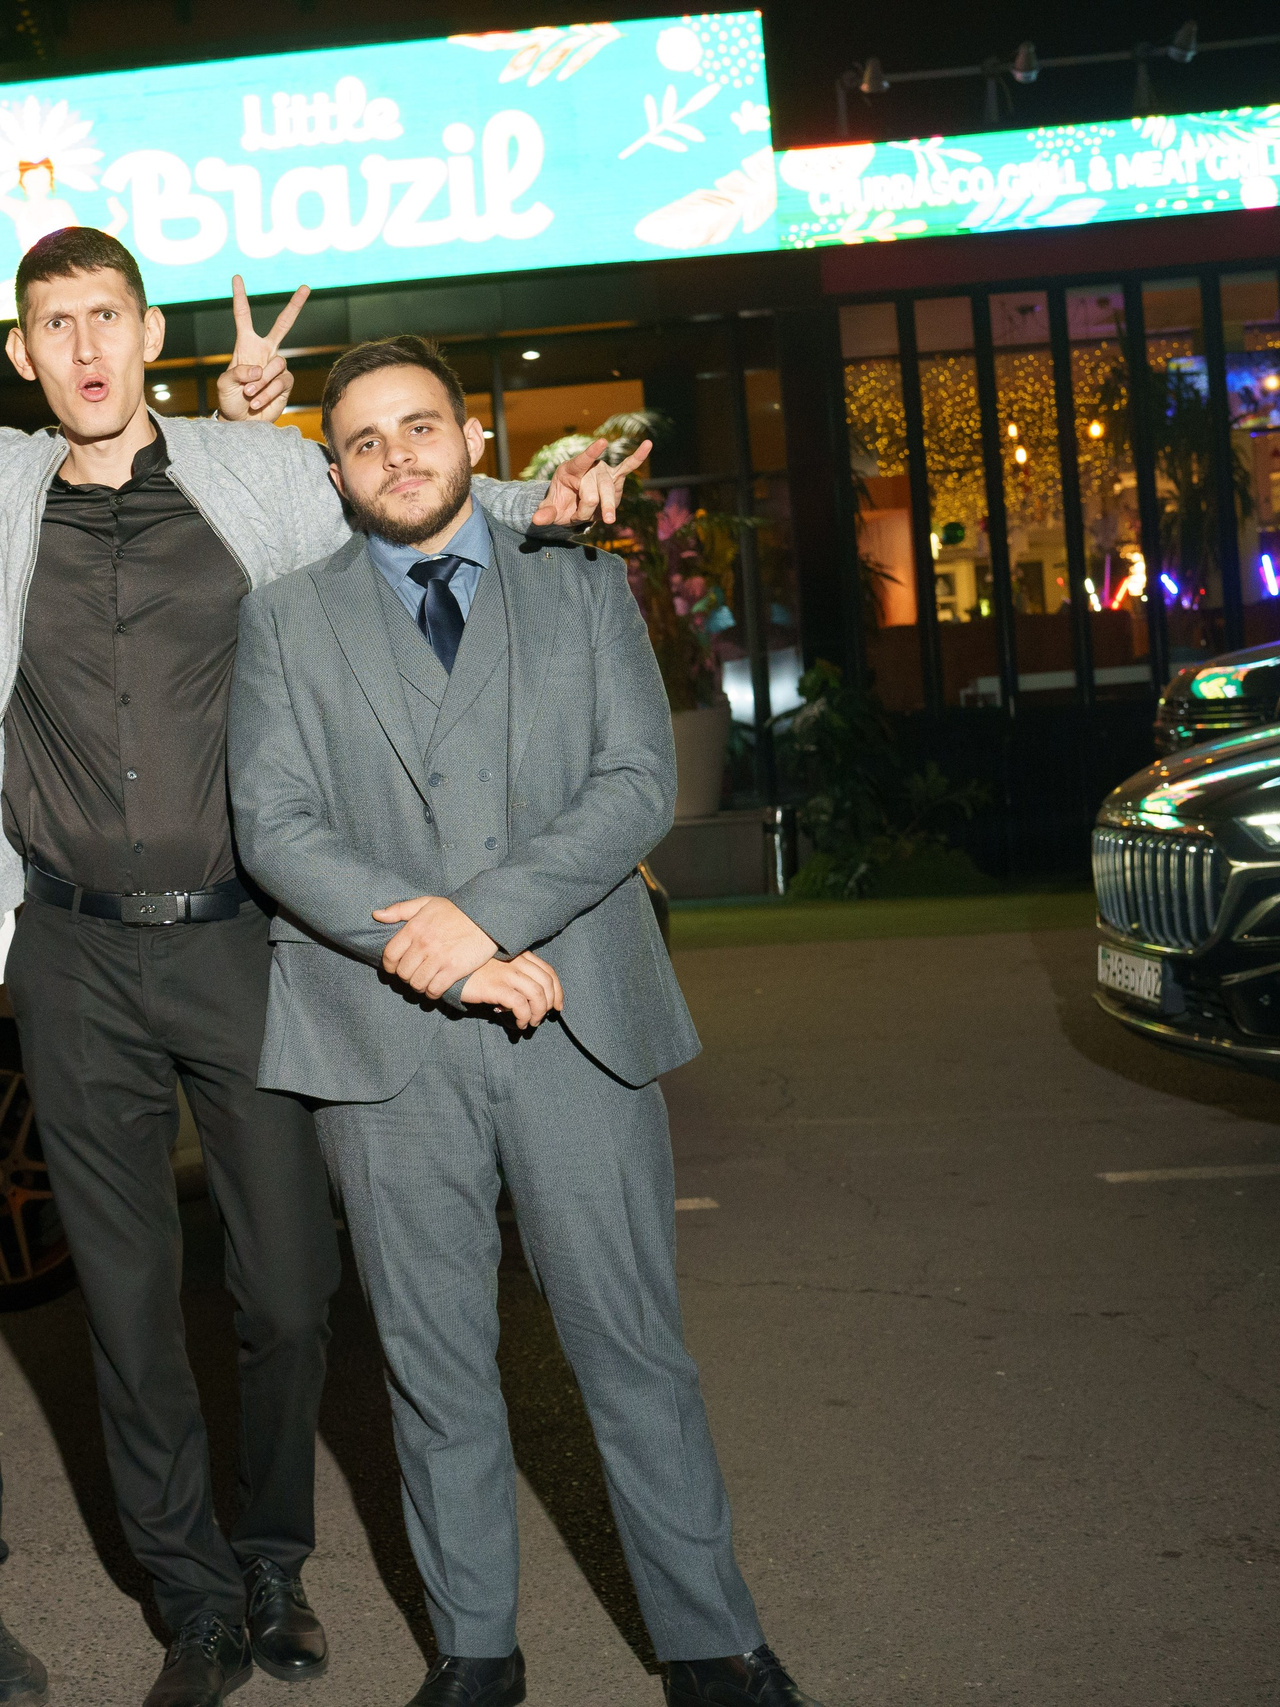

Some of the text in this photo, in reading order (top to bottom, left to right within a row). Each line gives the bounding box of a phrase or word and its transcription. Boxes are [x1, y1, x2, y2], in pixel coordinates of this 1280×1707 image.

[240, 75, 404, 152] Little
[101, 109, 555, 265] Brazil
[1088, 155, 1112, 192] &
[1115, 145, 1198, 189] MEAT
